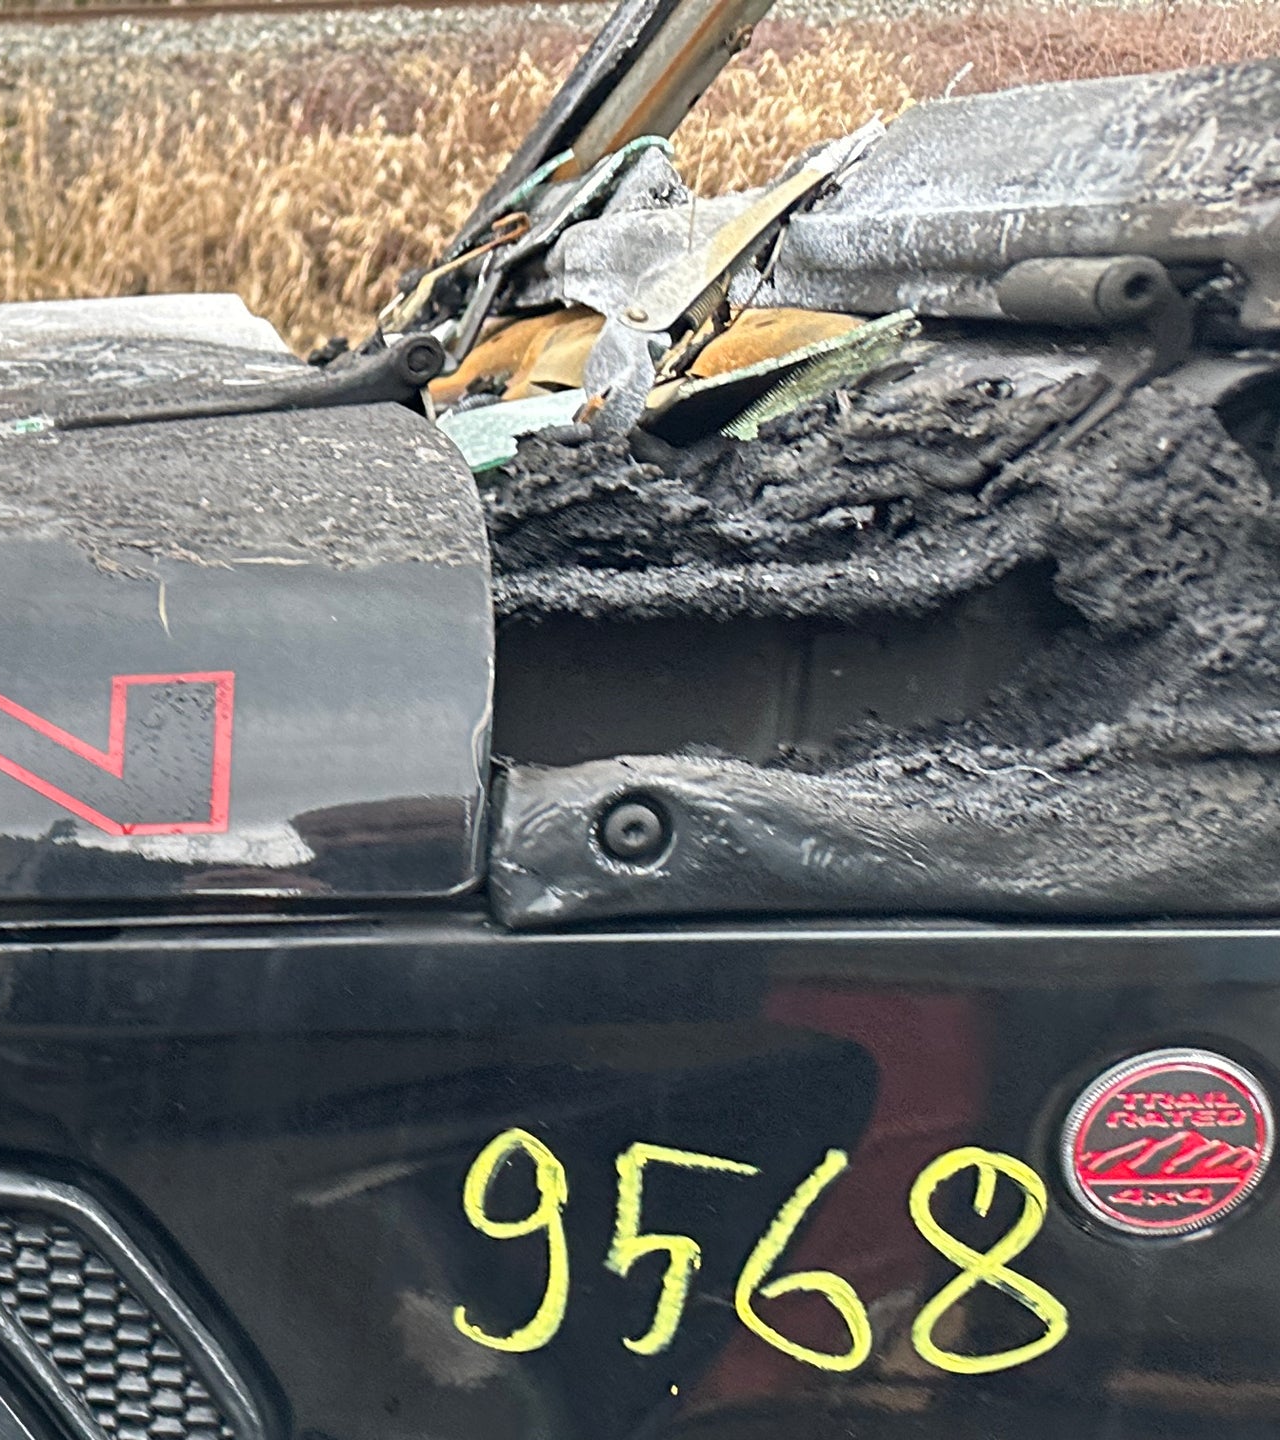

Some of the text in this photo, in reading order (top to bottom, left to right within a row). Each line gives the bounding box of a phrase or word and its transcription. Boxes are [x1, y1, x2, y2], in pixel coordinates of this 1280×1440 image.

[1115, 1091, 1241, 1111] TRAIL
[1105, 1110, 1247, 1128] RATED
[454, 1127, 1071, 1377] 9568
